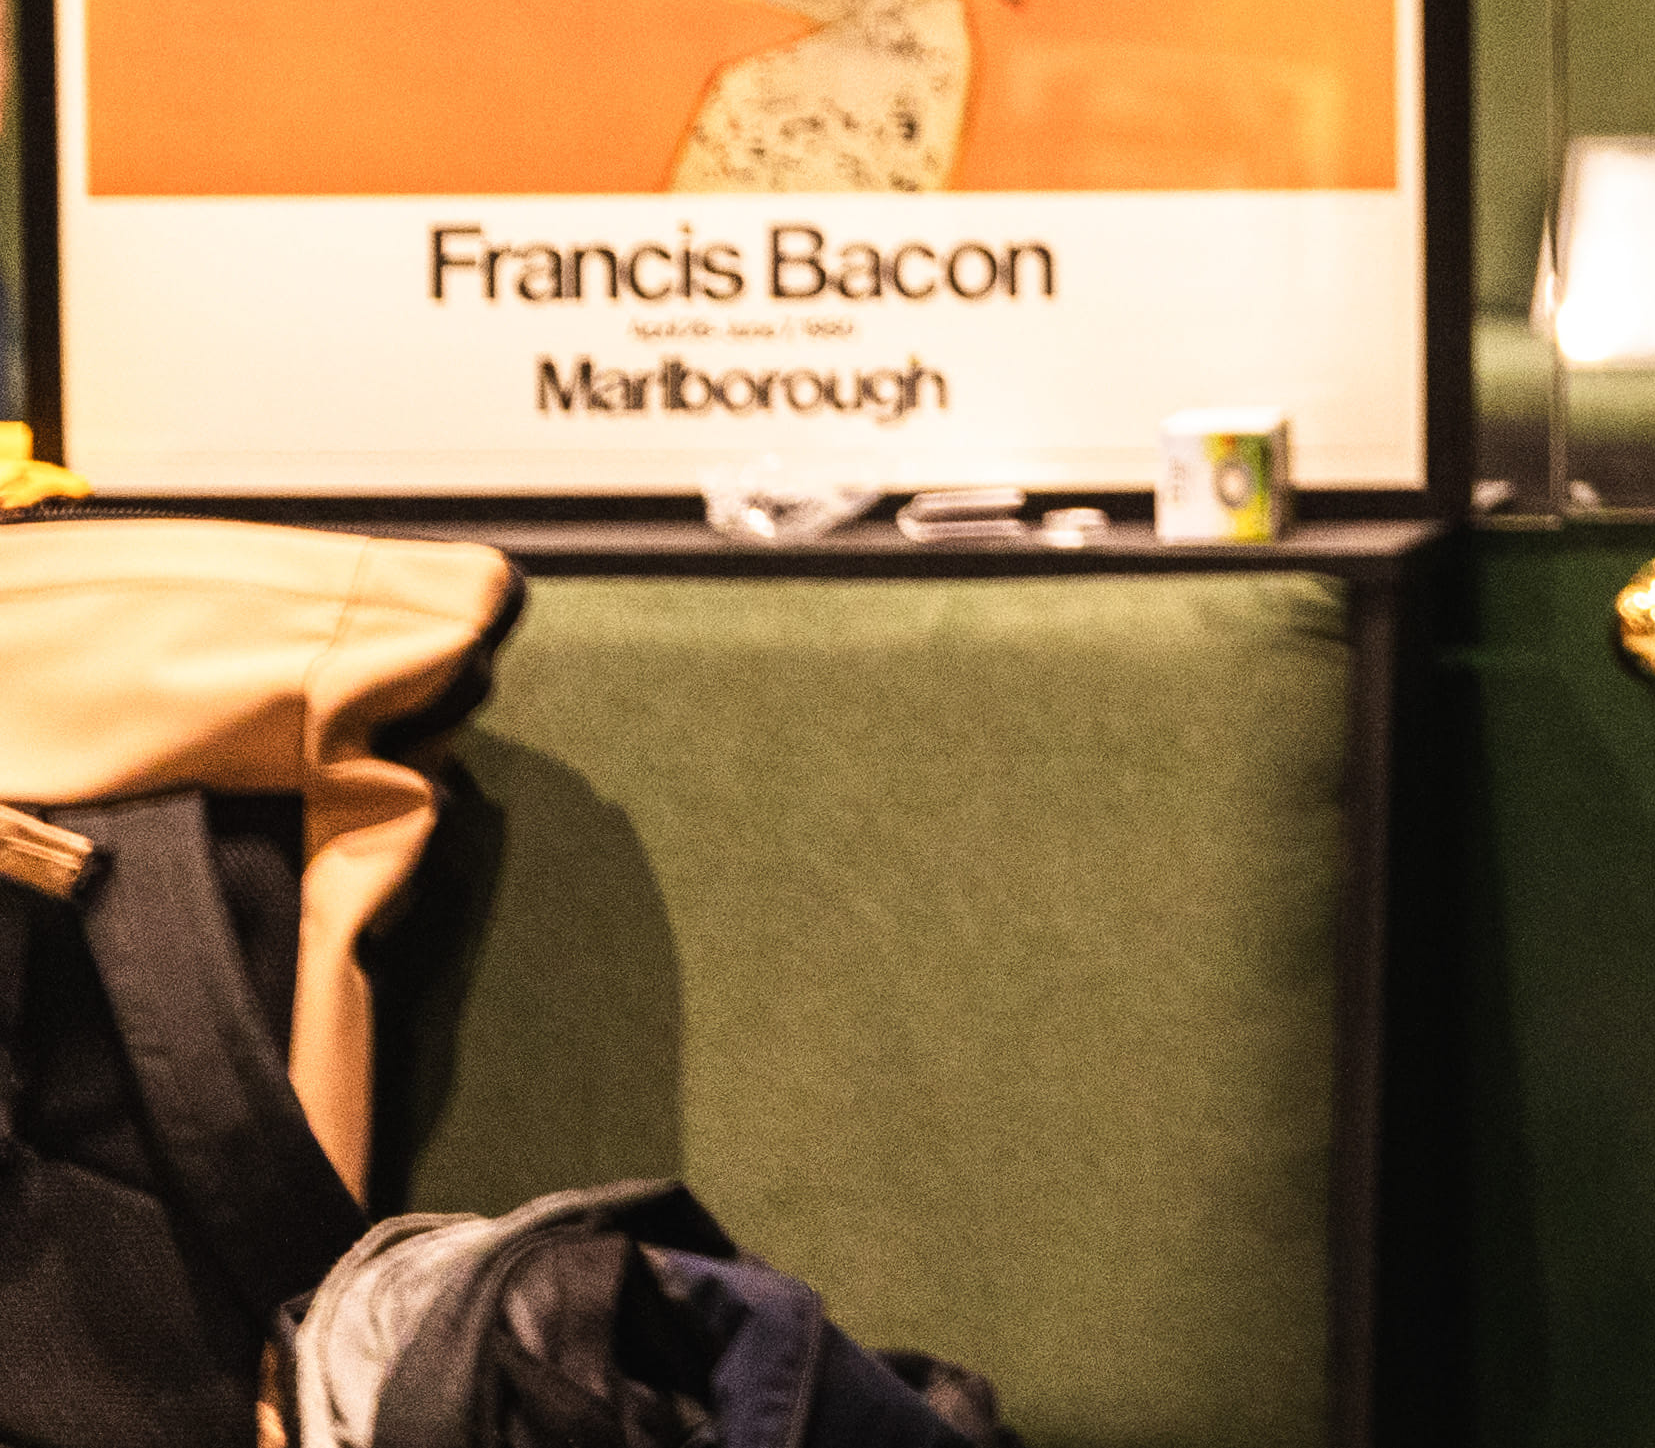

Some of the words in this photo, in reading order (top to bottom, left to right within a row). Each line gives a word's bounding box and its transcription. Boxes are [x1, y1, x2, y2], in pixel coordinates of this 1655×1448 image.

[428, 220, 745, 302] Francis
[768, 220, 1057, 302] Bacon
[534, 352, 950, 425] Marlborough
